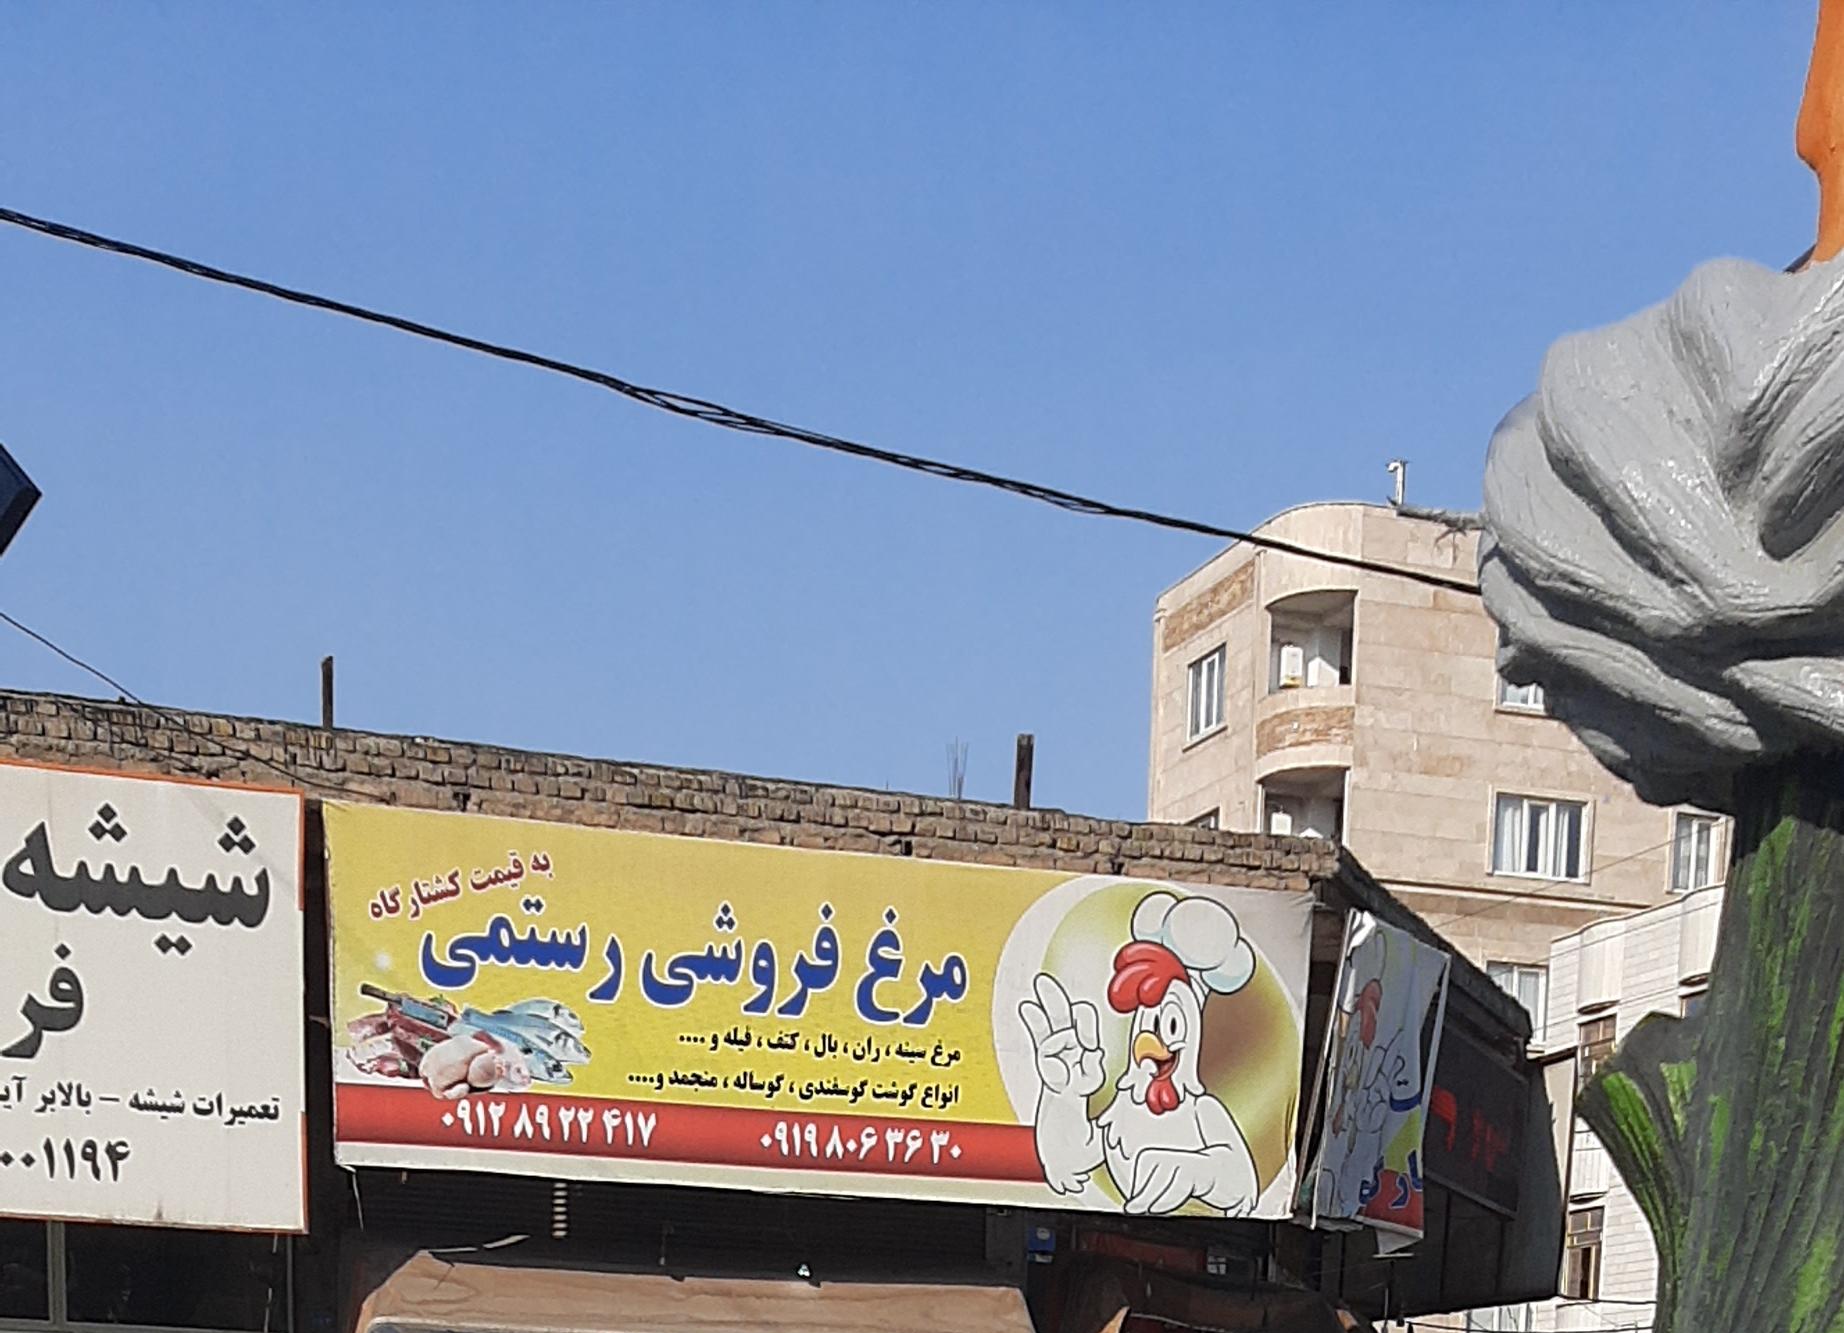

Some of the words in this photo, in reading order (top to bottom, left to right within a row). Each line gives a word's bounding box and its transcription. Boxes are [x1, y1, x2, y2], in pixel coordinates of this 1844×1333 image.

[2, 803, 270, 954] شیشه
[469, 851, 524, 891] قیمت
[531, 853, 554, 879] به
[421, 898, 624, 1001] رستمی
[642, 902, 840, 1015] فروشی
[855, 905, 968, 1025] مرغ
[814, 1034, 838, 1058] بال
[853, 1037, 880, 1062] ران
[930, 1042, 961, 1066] مرغ
[669, 1070, 718, 1092] منجمد
[733, 1072, 784, 1098] گوساله
[799, 1078, 868, 1103] گوسفندی
[872, 1081, 917, 1106] گوشت
[921, 1083, 959, 1108] انواع
[34, 1081, 92, 1115] بالابر
[128, 1088, 186, 1119] شیشه
[192, 1092, 281, 1125] تعمیرات
[441, 1099, 506, 1137] ۰۹۱۲
[602, 1108, 657, 1147] ۴۱۷
[760, 1121, 818, 1158] ۰۹۱۹
